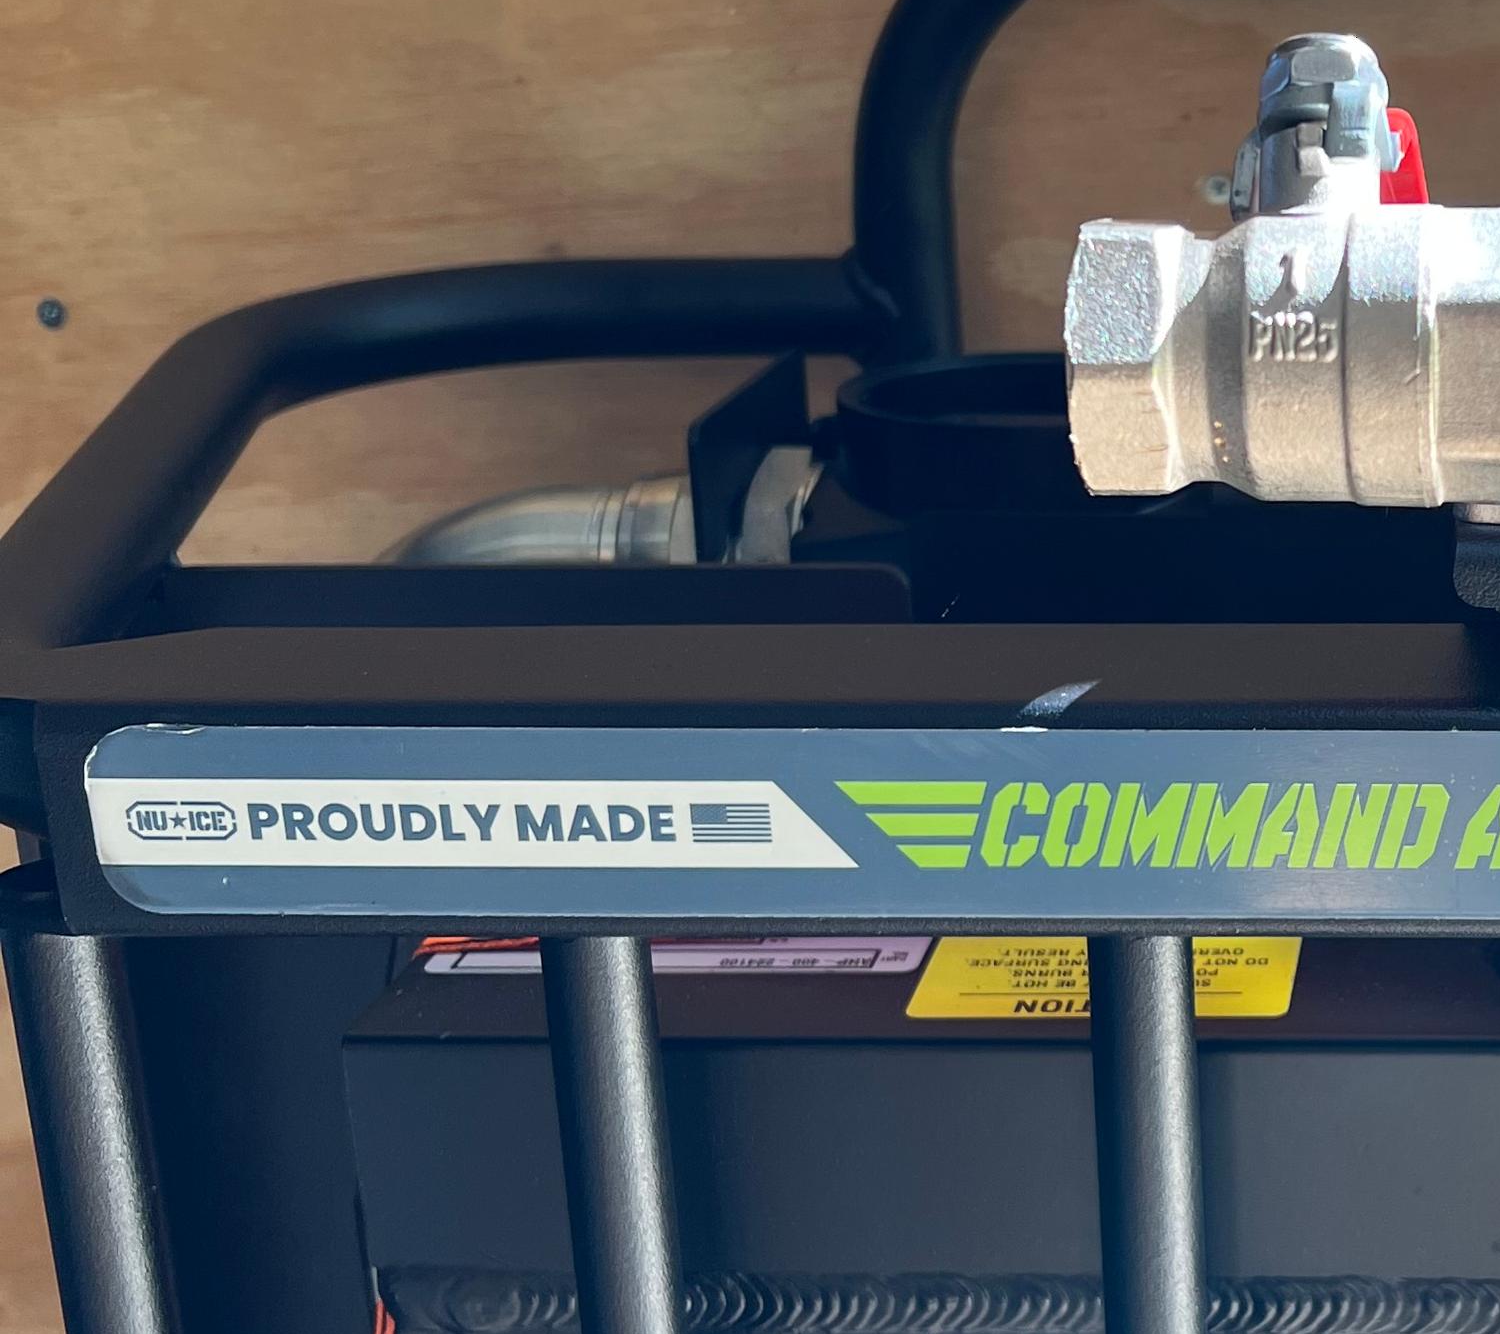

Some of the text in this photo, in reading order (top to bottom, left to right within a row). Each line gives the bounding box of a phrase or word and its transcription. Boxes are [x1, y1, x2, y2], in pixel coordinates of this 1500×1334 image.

[1248, 310, 1339, 363] PN25
[247, 802, 502, 843] PROUDLY
[516, 803, 677, 843] MADE
[980, 781, 1451, 870] COMMAND
[1202, 957, 1238, 966] NOT
[1244, 957, 1269, 966] DO
[1012, 998, 1090, 1014] TION
